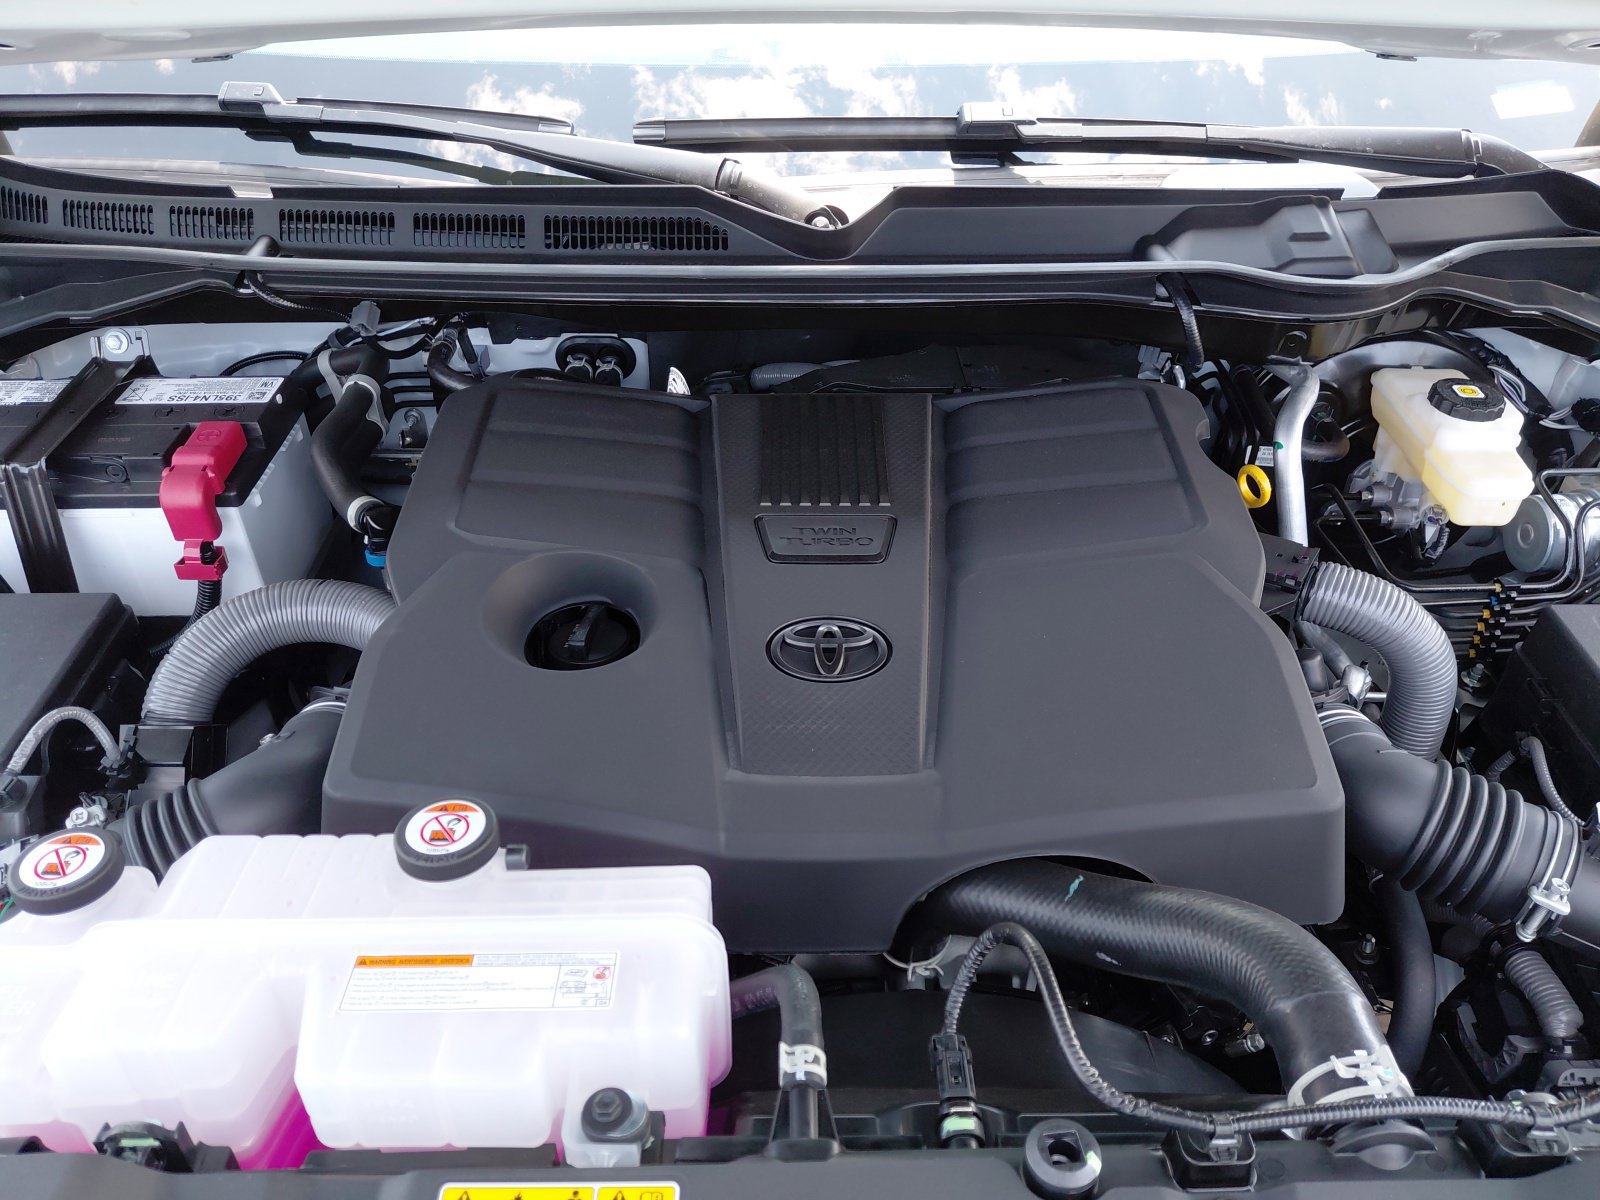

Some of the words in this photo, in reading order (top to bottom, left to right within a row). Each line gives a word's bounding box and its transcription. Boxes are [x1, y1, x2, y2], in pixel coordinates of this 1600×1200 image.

[167, 394, 241, 402] 395LN4-ISS
[791, 527, 857, 536] TWIN
[779, 536, 874, 546] TURBO
